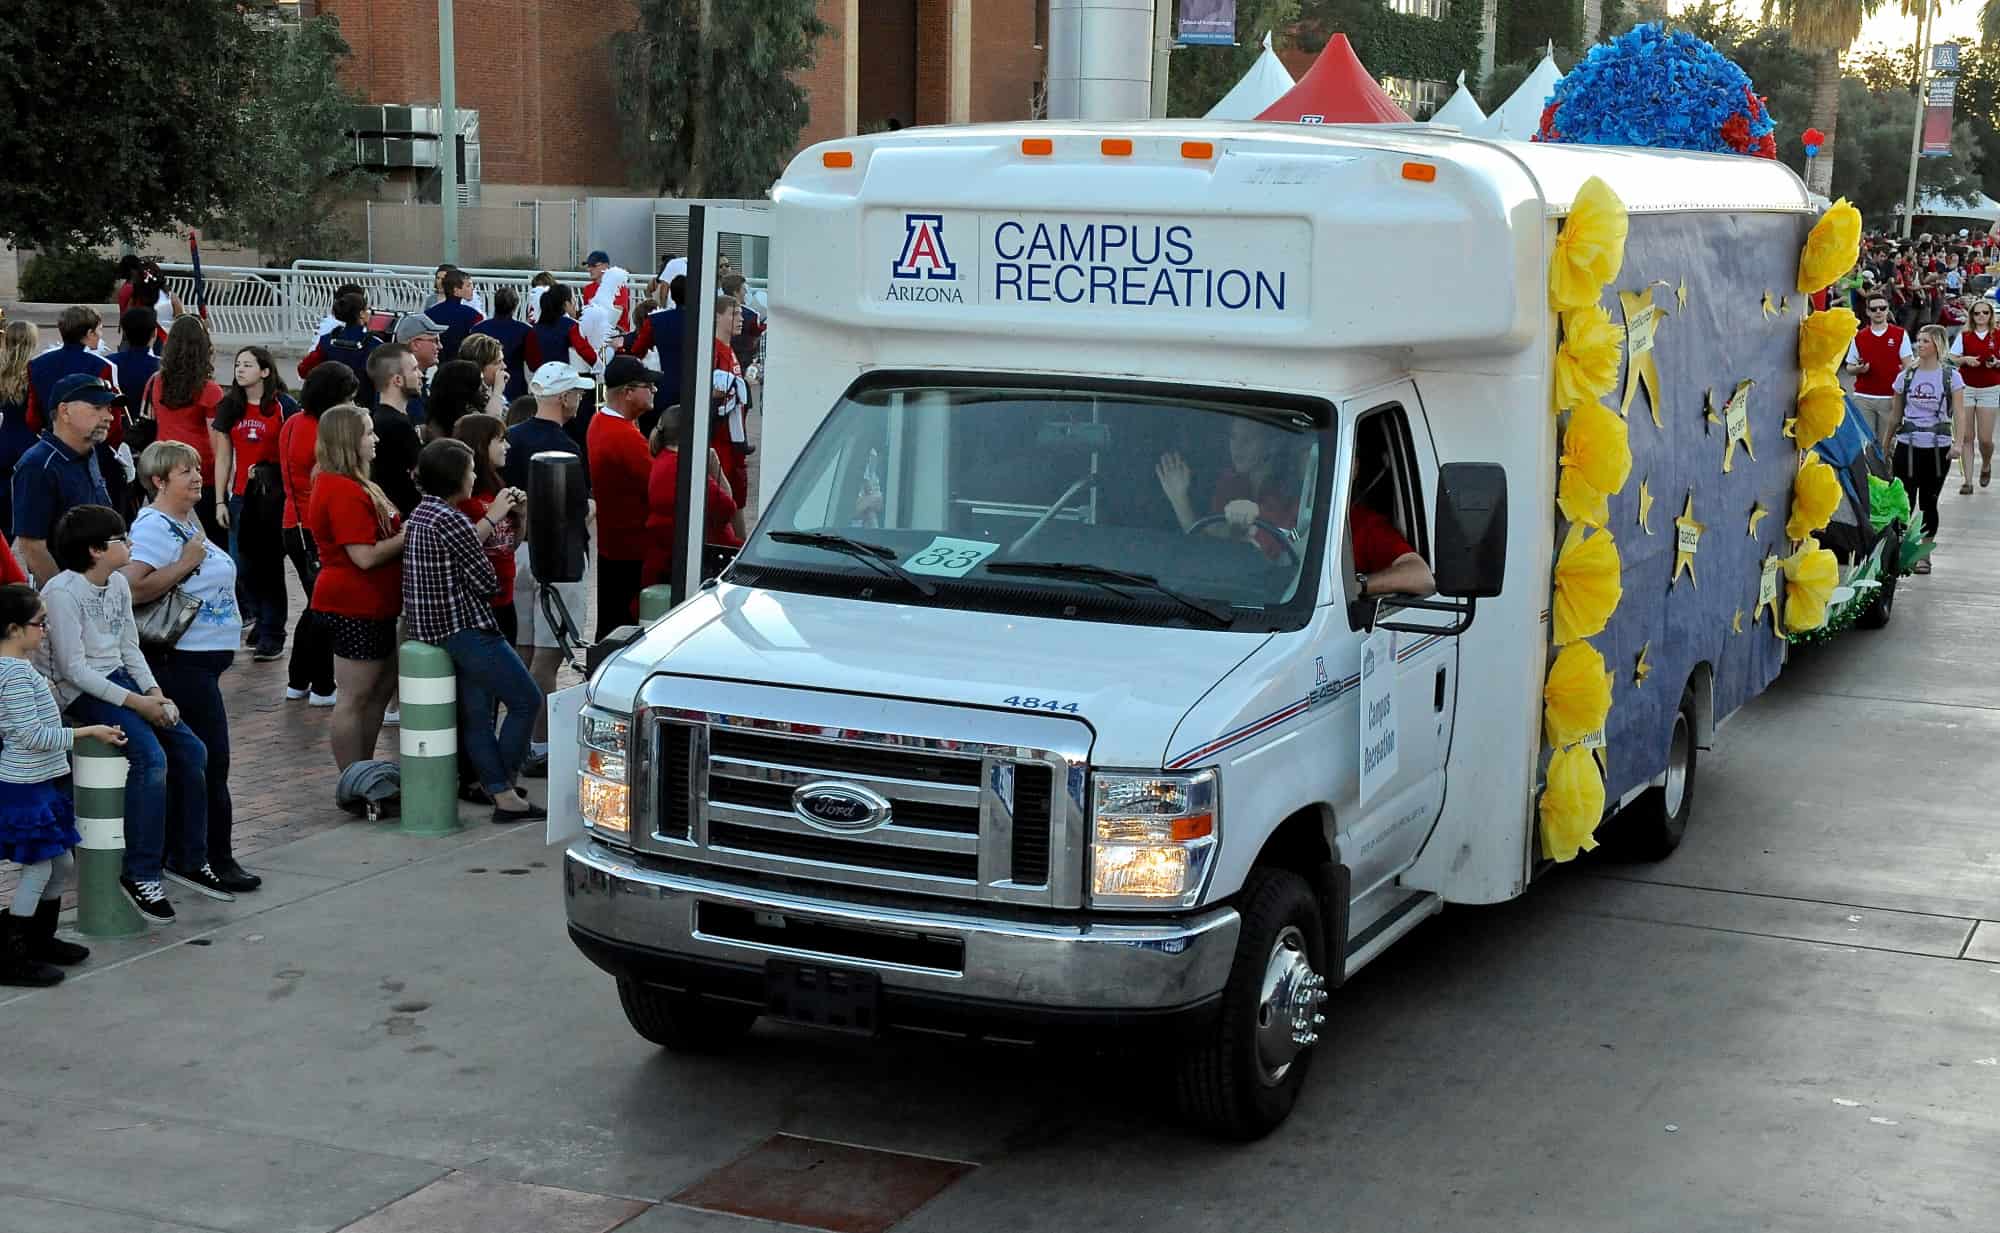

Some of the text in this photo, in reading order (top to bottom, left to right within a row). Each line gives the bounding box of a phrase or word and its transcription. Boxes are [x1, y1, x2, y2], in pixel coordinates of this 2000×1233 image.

[892, 213, 957, 281] A
[994, 221, 1194, 266] CAMPUS
[886, 282, 964, 304] ARIZONA
[994, 263, 1286, 311] RECREATION
[915, 547, 982, 569] 33
[1003, 695, 1080, 713] 4844
[1368, 692, 1391, 730] Campus
[1364, 730, 1395, 776] Recreation
[814, 794, 856, 817] Ford
